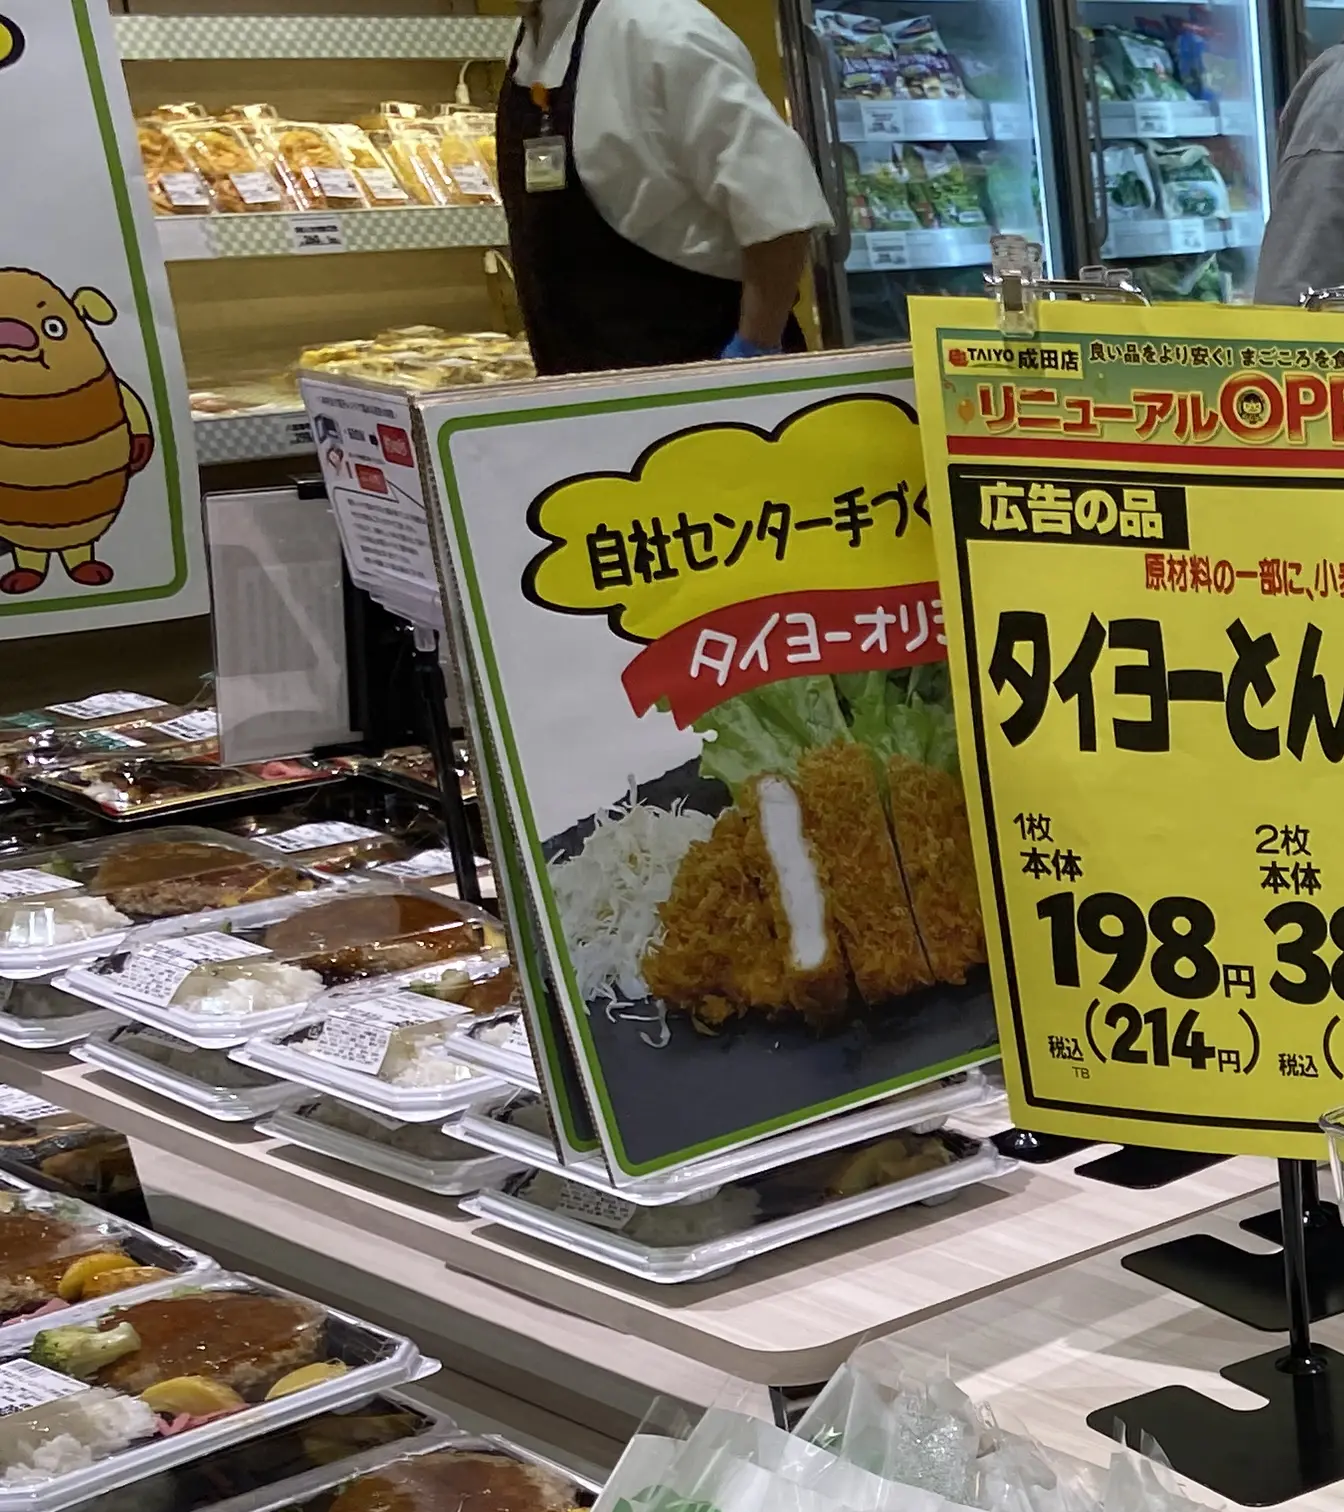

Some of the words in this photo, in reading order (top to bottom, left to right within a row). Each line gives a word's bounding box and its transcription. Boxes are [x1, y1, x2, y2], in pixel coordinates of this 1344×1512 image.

[968, 346, 1015, 364] TAIYO
[1018, 348, 1080, 372] 成田店
[979, 481, 1165, 540] 広告の品
[1013, 812, 1054, 843] 1枚
[1254, 823, 1311, 857] 2枚
[1020, 848, 1084, 882] 本体
[1259, 861, 1322, 895] 本体
